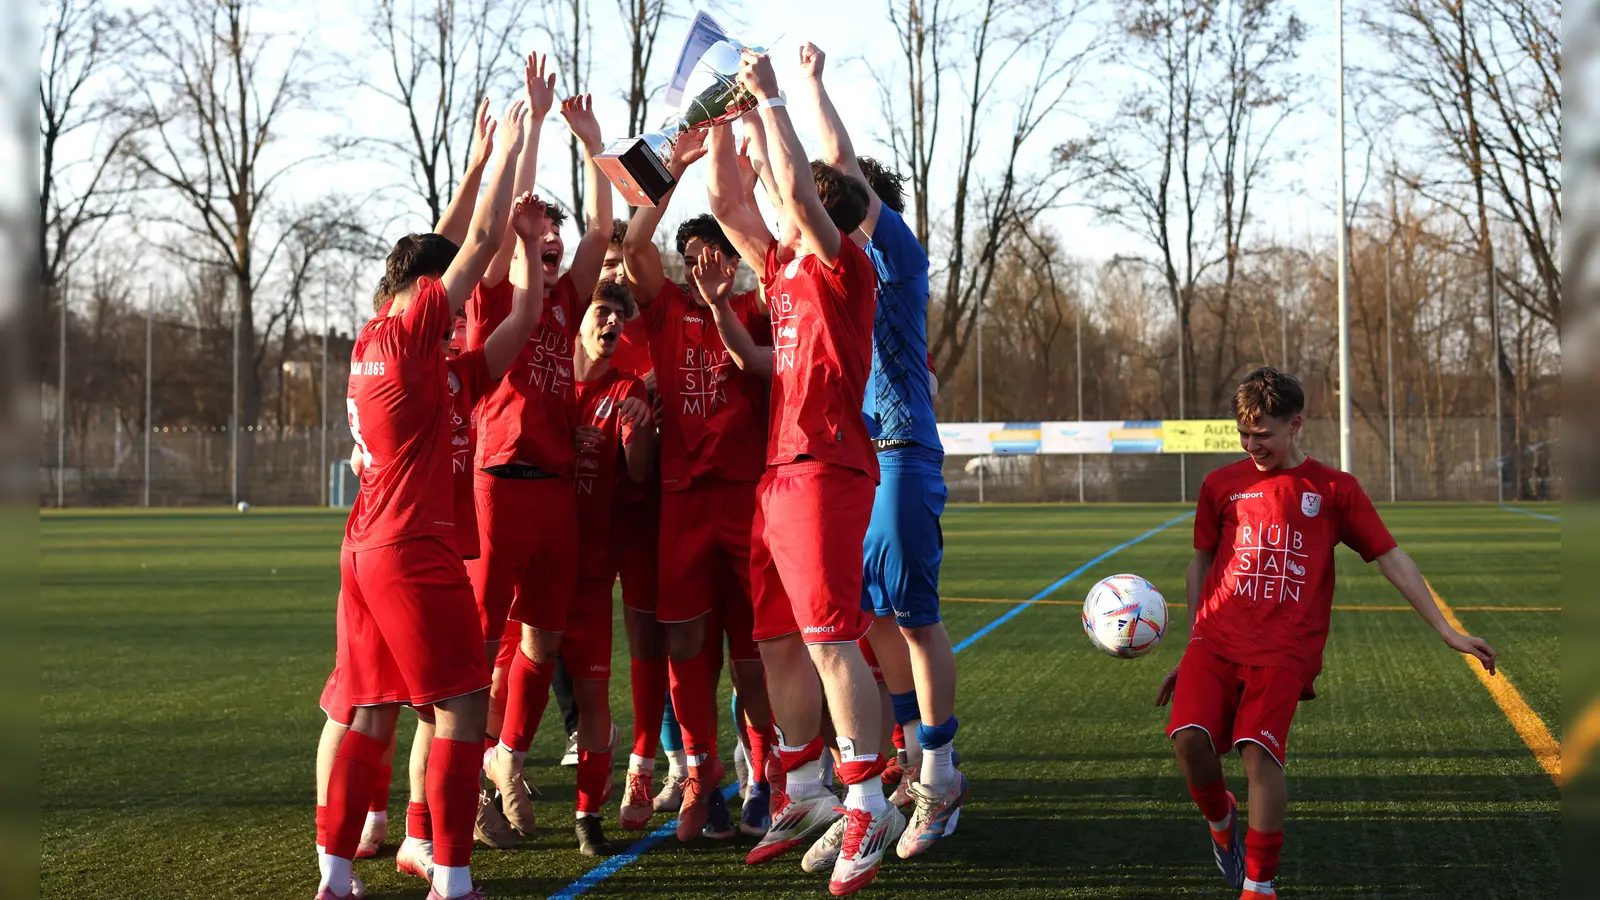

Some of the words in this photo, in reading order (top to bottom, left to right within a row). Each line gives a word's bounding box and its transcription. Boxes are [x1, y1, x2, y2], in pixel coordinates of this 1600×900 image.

[363, 361, 385, 376] 1865
[1230, 491, 1263, 501] uhlsport
[803, 624, 835, 635] uhlsport
